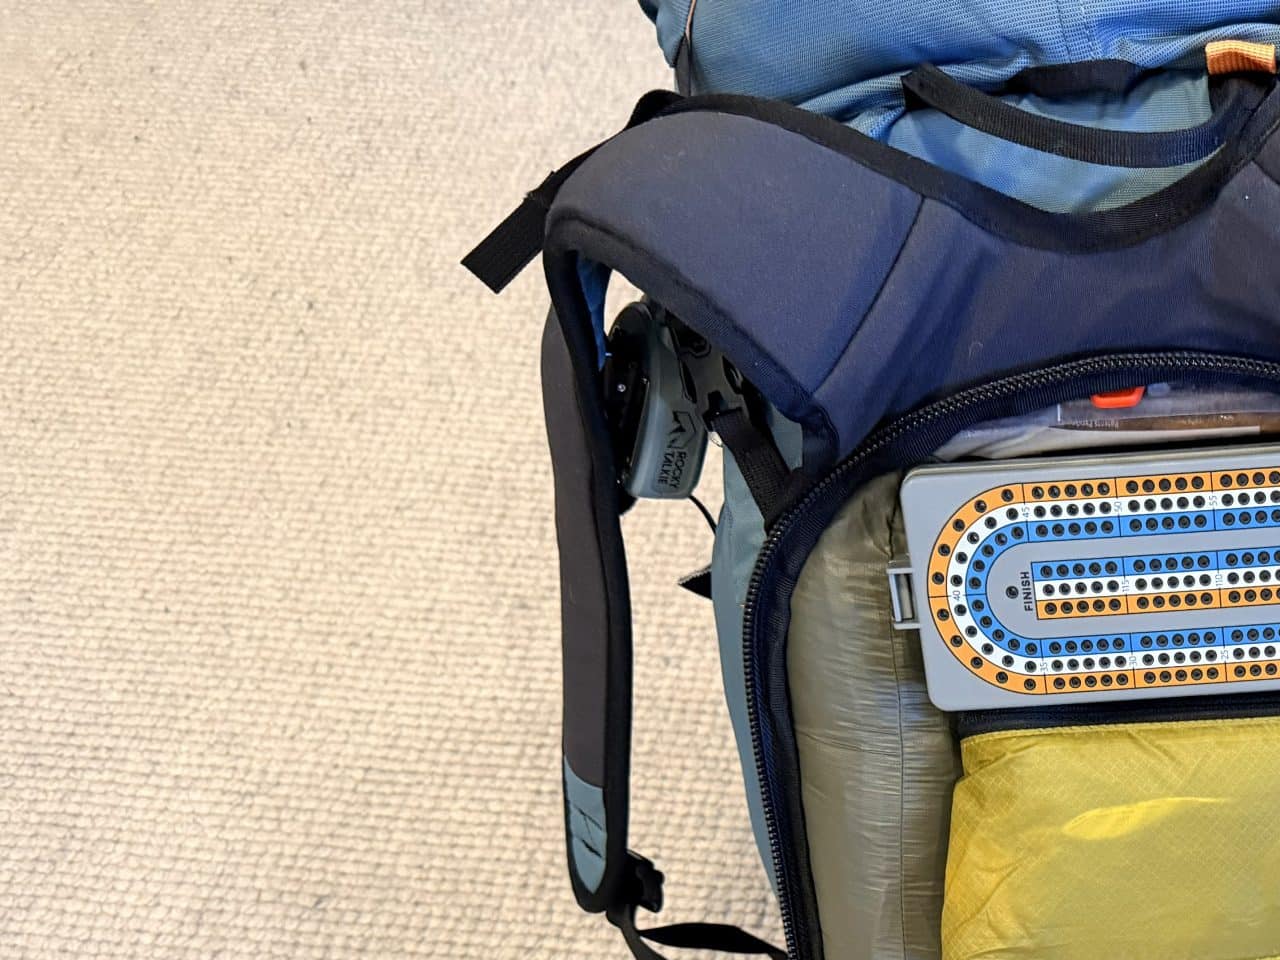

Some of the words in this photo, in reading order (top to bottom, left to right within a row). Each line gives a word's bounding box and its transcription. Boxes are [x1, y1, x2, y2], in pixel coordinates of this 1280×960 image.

[657, 452, 675, 485] TALKIE
[669, 451, 687, 488] ROCKY
[1208, 494, 1218, 506] 55
[1021, 506, 1031, 518] 45
[1113, 501, 1122, 513] 50
[1121, 579, 1130, 593] 115
[1214, 573, 1223, 587] 110
[951, 589, 961, 601] 40
[1019, 571, 1033, 612] FINISH
[1220, 649, 1229, 660] 25
